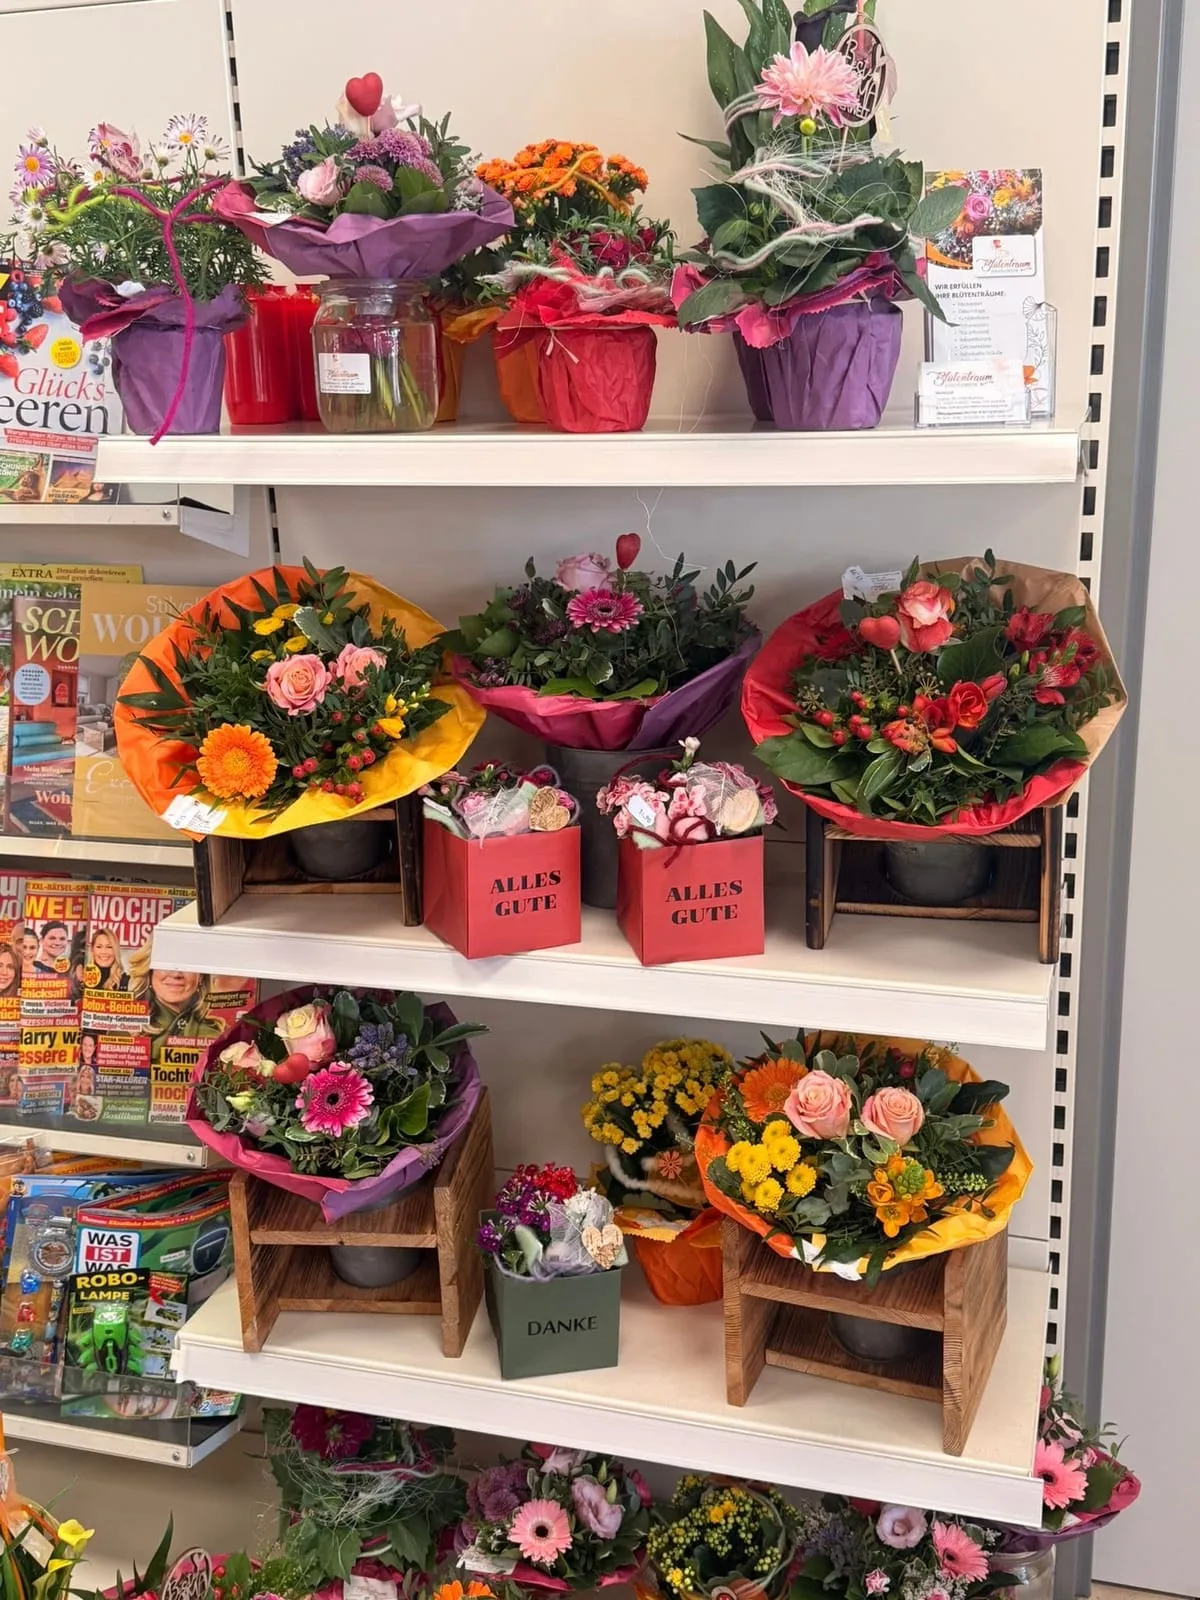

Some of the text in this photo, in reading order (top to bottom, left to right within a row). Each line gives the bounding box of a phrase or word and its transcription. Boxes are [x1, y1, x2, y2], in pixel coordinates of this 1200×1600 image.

[949, 282, 982, 290] ERFÜLLEN
[14, 367, 115, 402] Glücks-
[12, 568, 53, 579] EXTRA
[490, 869, 562, 895] ALLES
[665, 879, 743, 903] ALLES
[90, 895, 172, 923] WOCHE
[495, 894, 557, 917] GUTE
[671, 903, 739, 925] GUTE
[106, 991, 132, 999] FISCHER
[82, 998, 146, 1013] Botox-Beichte
[55, 1018, 79, 1026] DIANA
[100, 1043, 146, 1053] NEUANFANG
[164, 1048, 200, 1064] Kann
[152, 1103, 178, 1112] DRAMA
[142, 1218, 175, 1227] Intelligenz
[88, 1231, 133, 1247] WAS
[93, 1248, 127, 1261] IST
[76, 1272, 145, 1289] ROBO-
[80, 1290, 130, 1301] LAMPE
[527, 1315, 599, 1336] DANKE
